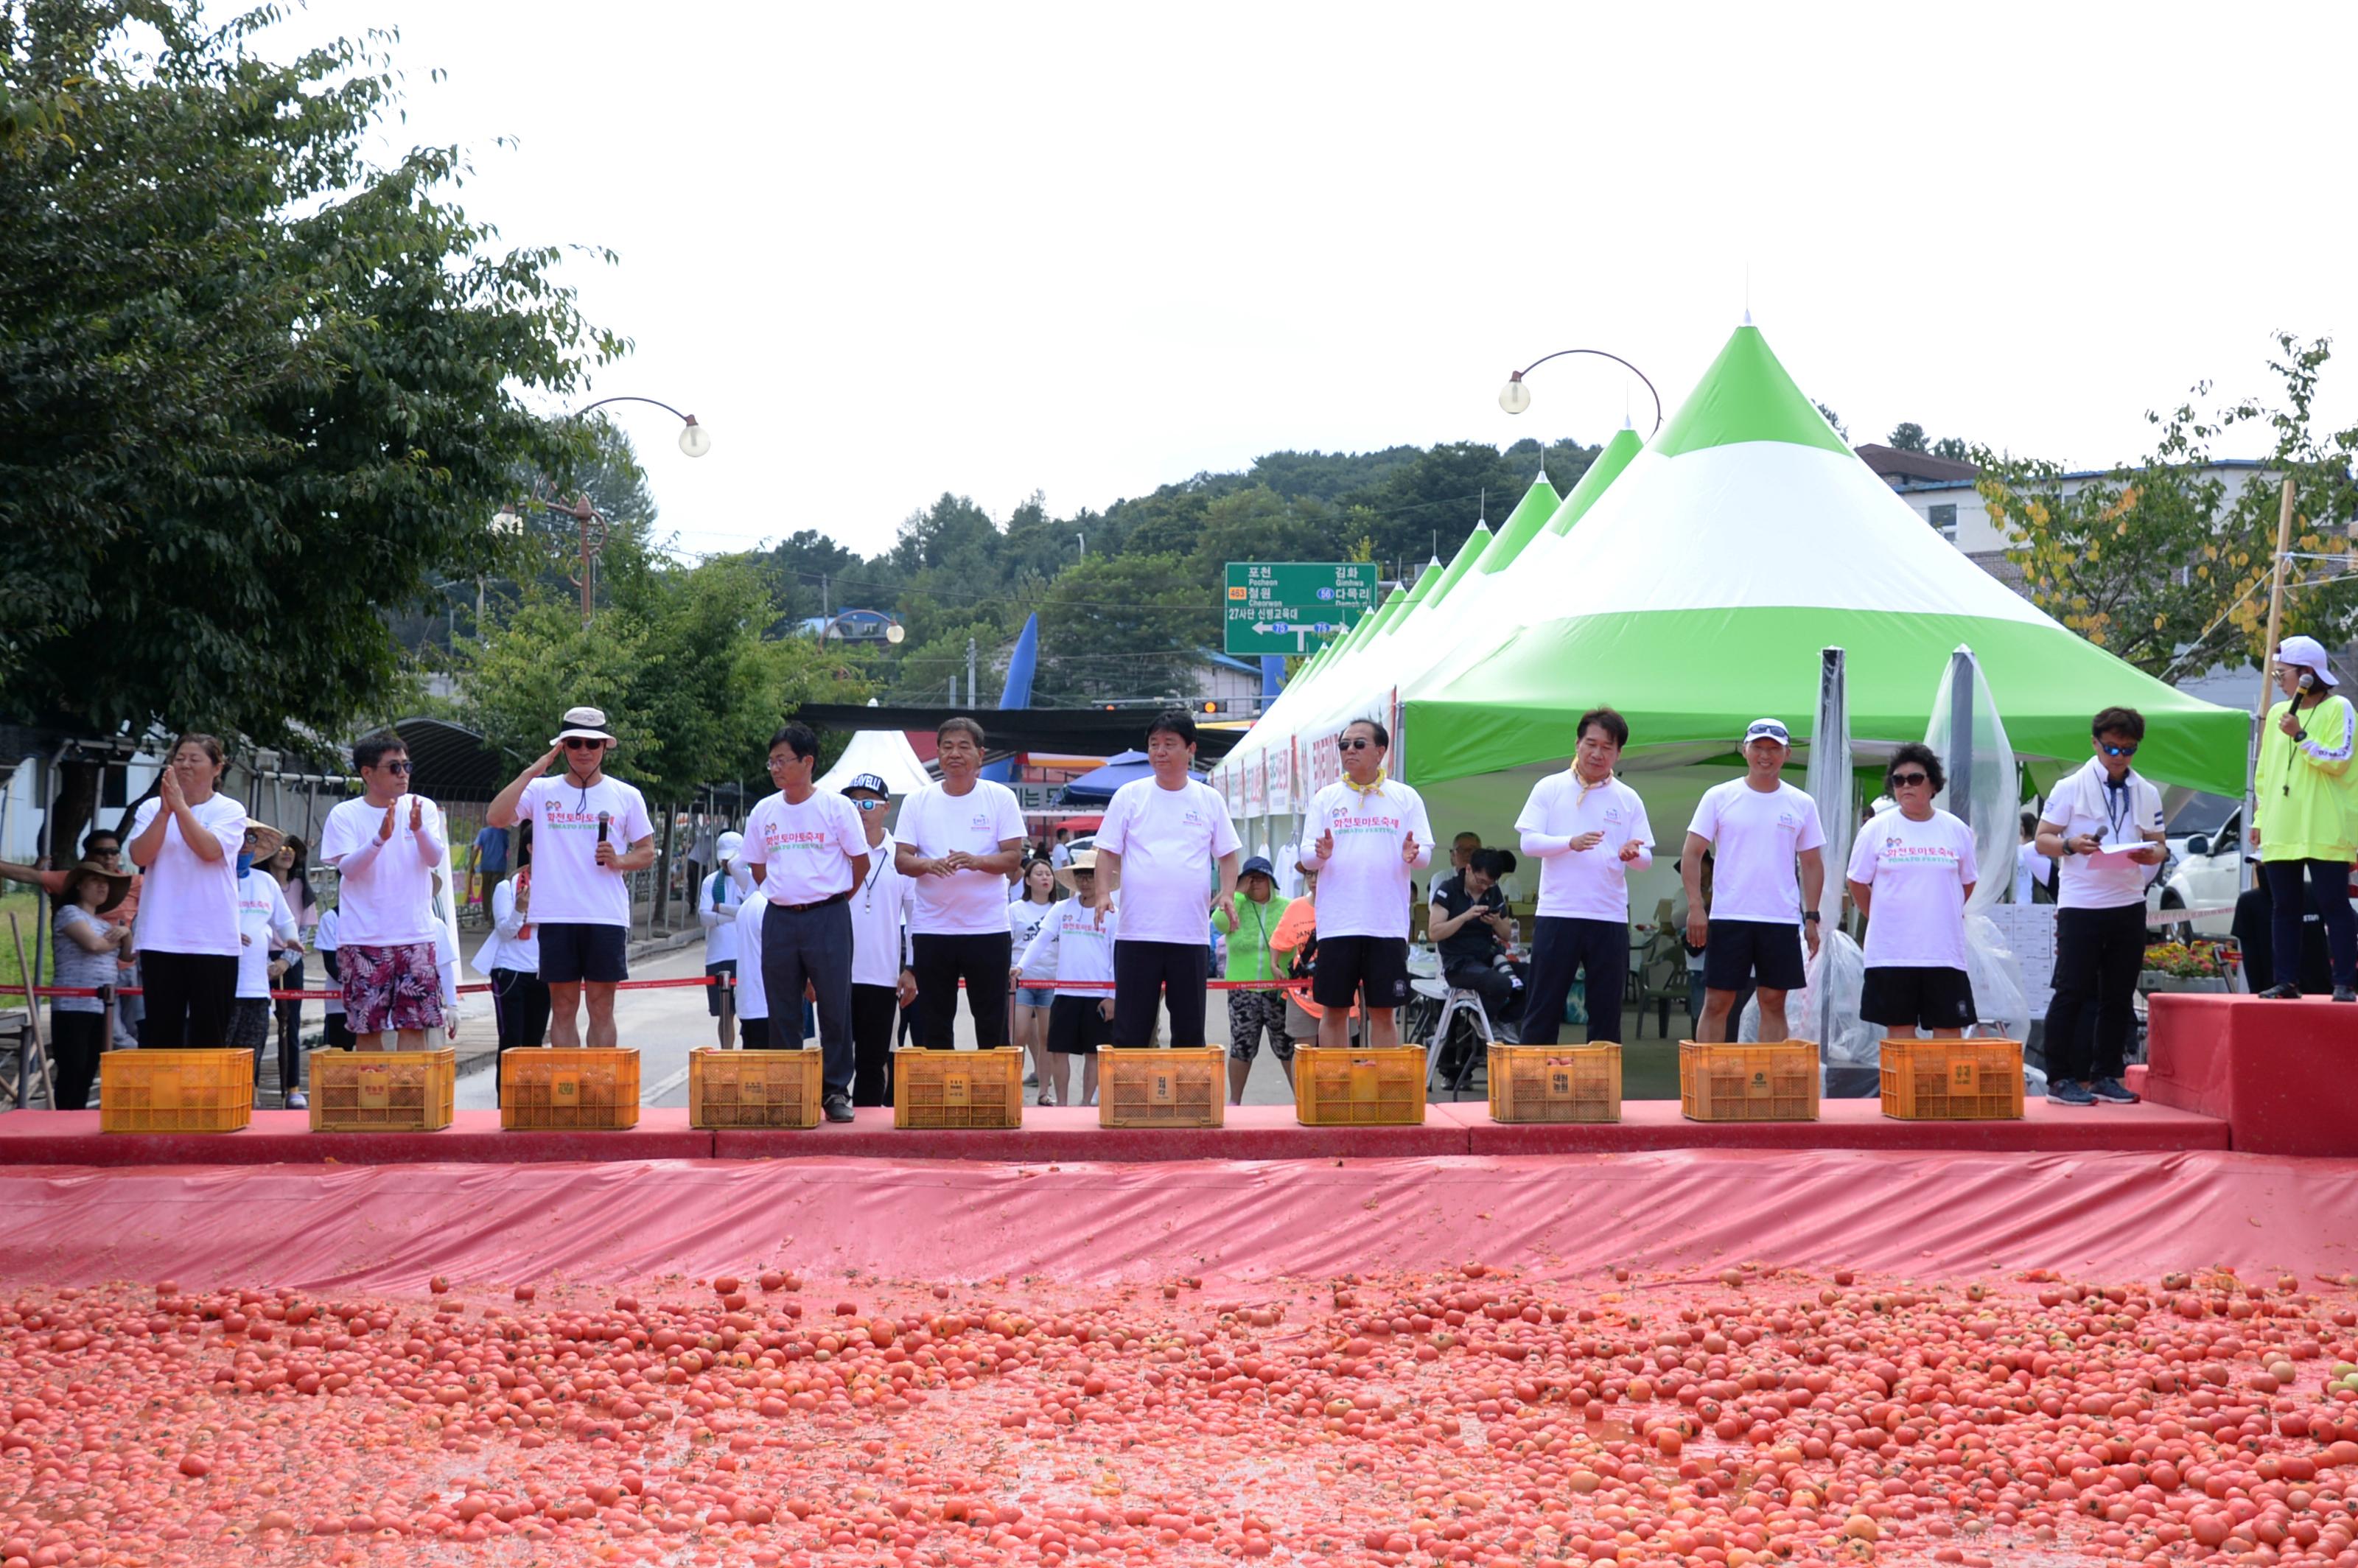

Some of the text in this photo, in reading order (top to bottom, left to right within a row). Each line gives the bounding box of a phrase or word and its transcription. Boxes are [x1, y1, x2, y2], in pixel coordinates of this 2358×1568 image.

[1248, 567, 1271, 578] 포천
[1335, 567, 1359, 578] 김화
[1249, 587, 1271, 599] 철원
[1228, 609, 1255, 620] 27사단
[1275, 623, 1285, 633] 75
[1317, 623, 1327, 633] 75
[1333, 816, 1399, 828] 화천토마토축제
[1334, 827, 1363, 835] TOMATO
